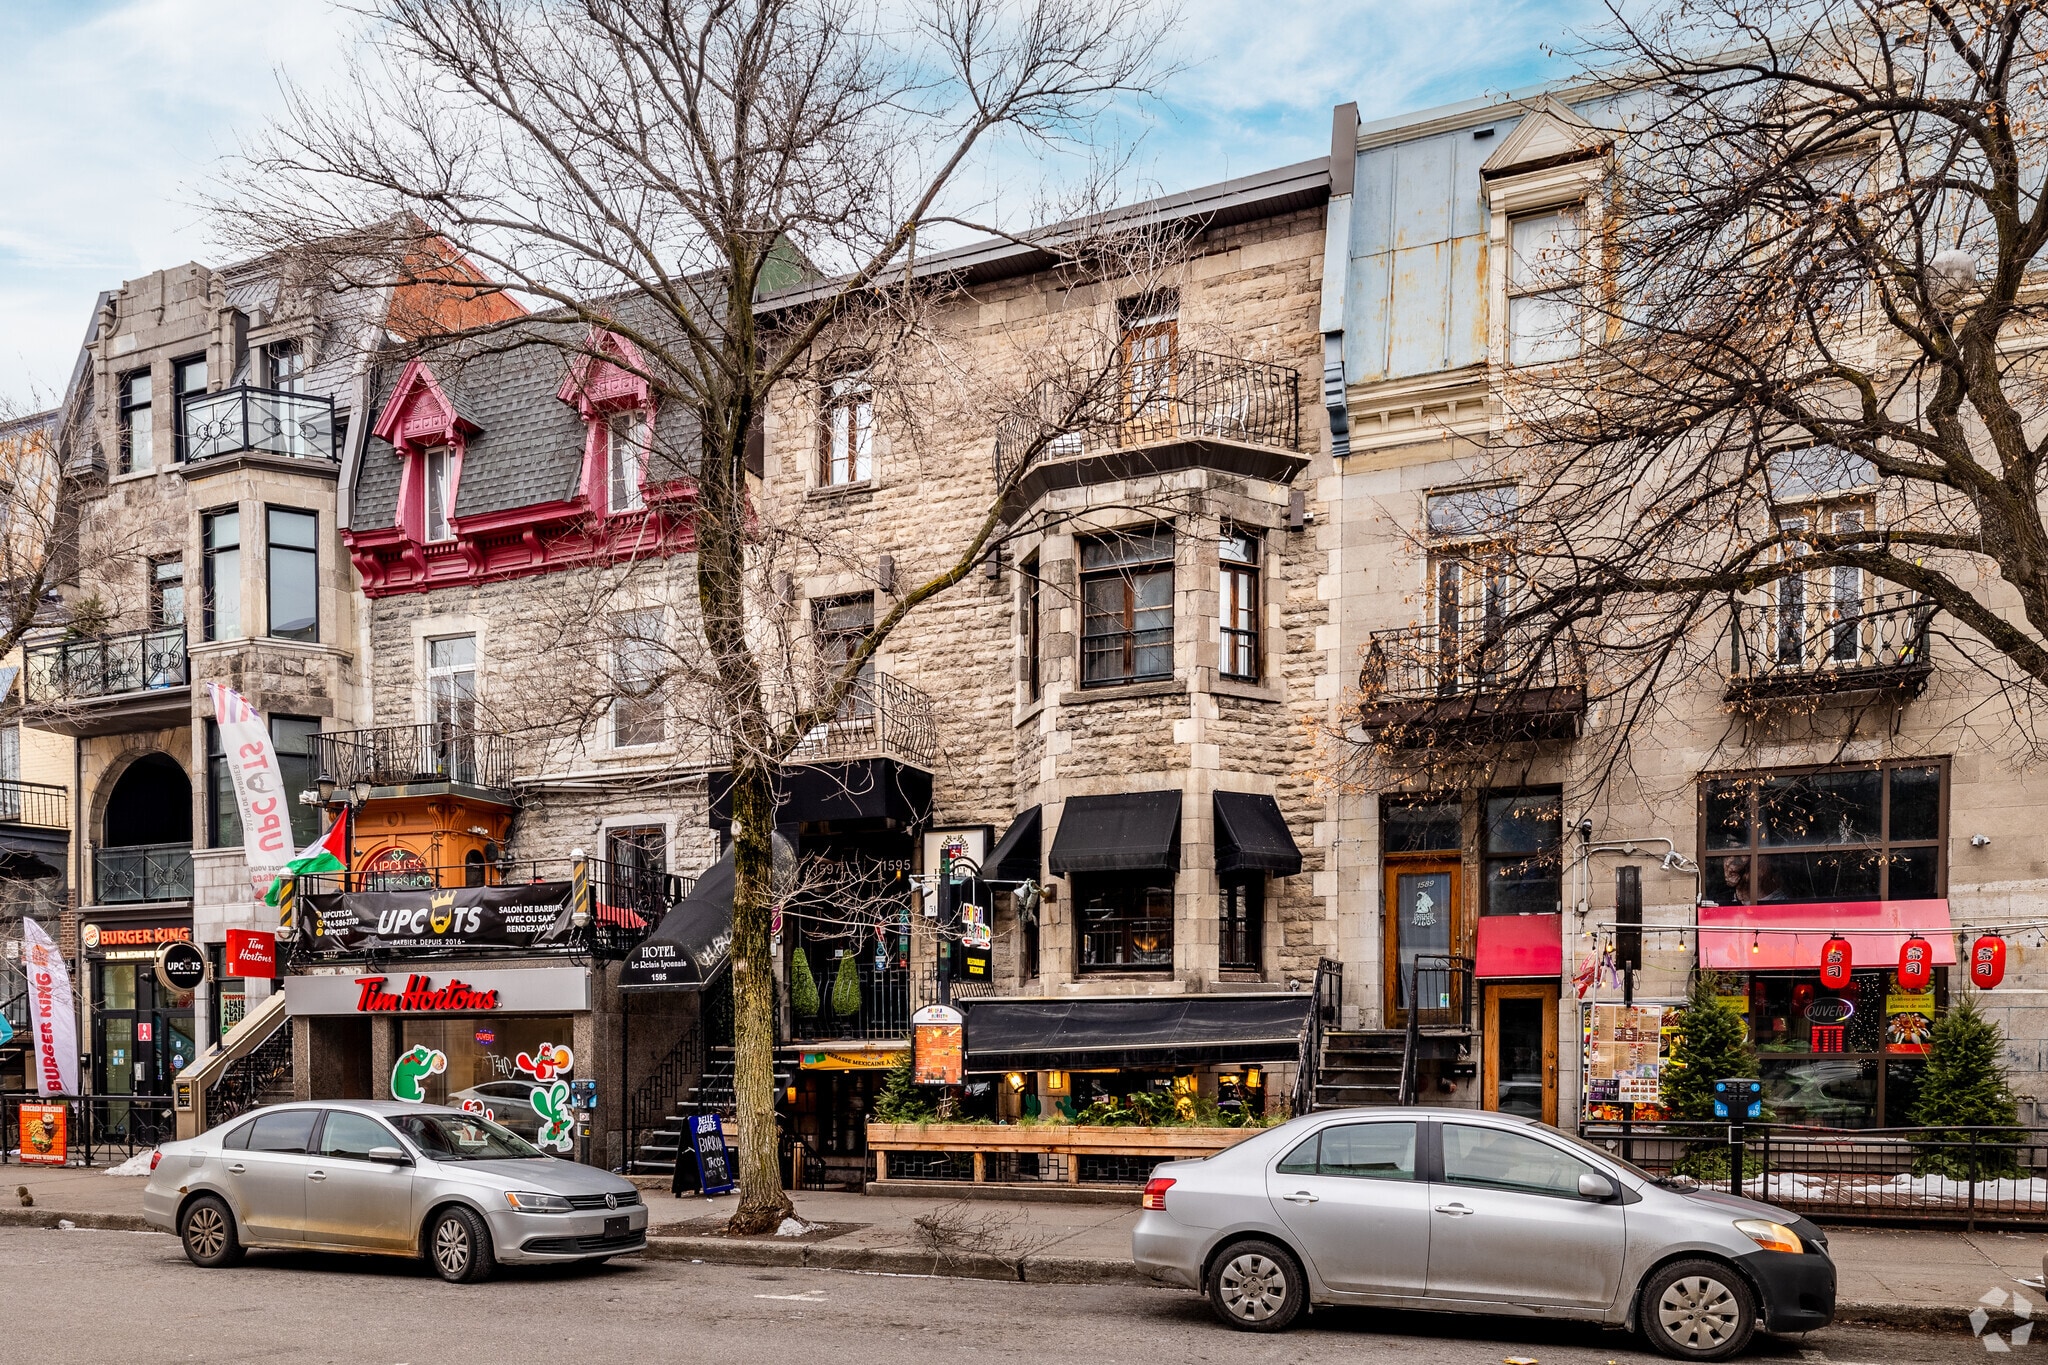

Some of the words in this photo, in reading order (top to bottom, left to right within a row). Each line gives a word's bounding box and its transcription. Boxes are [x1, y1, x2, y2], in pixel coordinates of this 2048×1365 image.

[882, 859, 911, 871] 1595
[1417, 880, 1435, 888] 1589
[322, 909, 353, 919] UPCUTS.CA
[498, 905, 522, 914] SALON
[523, 905, 533, 913] DE
[505, 915, 525, 923] AVEC
[525, 915, 537, 923] OU
[100, 929, 153, 945] BURGER
[153, 927, 189, 942] KING
[247, 938, 264, 950] Tim
[239, 948, 272, 963] Hortons
[642, 945, 676, 958] HOTEL
[631, 961, 639, 969] Le
[640, 959, 660, 968] Relais
[661, 959, 687, 970] Lyonnais
[651, 973, 667, 981] 1595
[35, 972, 52, 1019] KING
[354, 976, 401, 1011] Tim
[401, 973, 497, 1011] Hortons
[1806, 1004, 1851, 1017] OUVERT
[476, 1032, 495, 1041] OUVERT
[40, 1021, 63, 1092] BURGER
[852, 1059, 885, 1067] MEXICAINE
[697, 1115, 713, 1125] BELLE
[697, 1121, 717, 1134] GUEULE
[706, 1157, 725, 1168] TACOS
